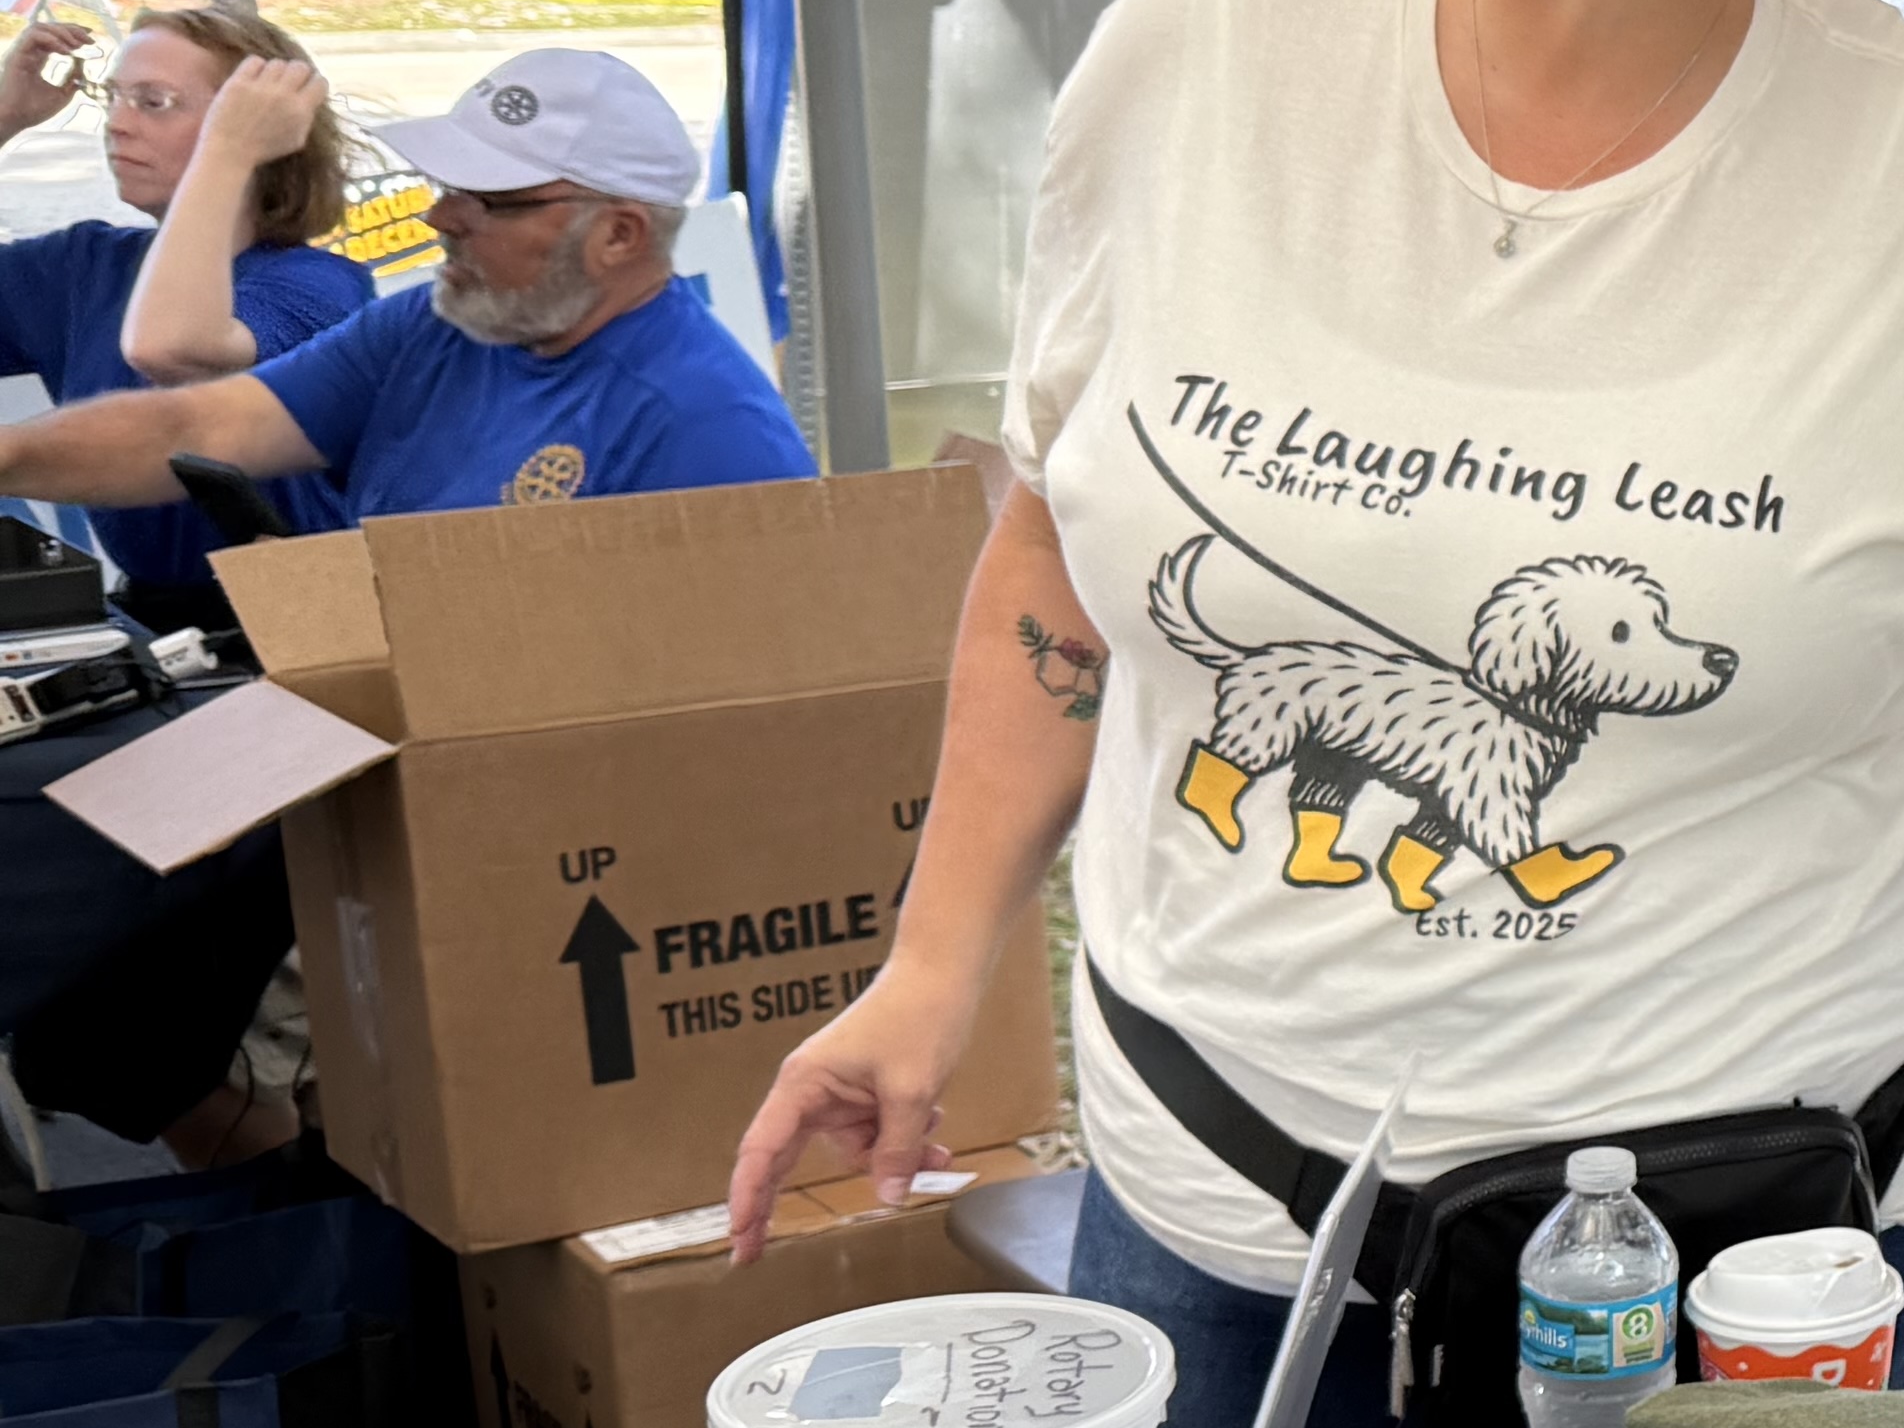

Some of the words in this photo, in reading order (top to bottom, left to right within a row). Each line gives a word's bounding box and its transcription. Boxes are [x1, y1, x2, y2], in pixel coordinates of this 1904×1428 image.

[1168, 373, 1264, 448] The
[1276, 407, 1587, 522] Laughing
[1615, 462, 1786, 533] Leash
[1218, 449, 1354, 502] T-Shirt
[1359, 483, 1414, 518] Co.
[892, 796, 930, 831] U
[557, 845, 618, 885] UP
[653, 892, 878, 974] FRAGILE
[1415, 907, 1479, 940] Est.
[1496, 911, 1579, 942] 2025
[657, 980, 742, 1040] THIS
[751, 972, 836, 1027] SIDE
[1024, 1328, 1122, 1418] Rotary
